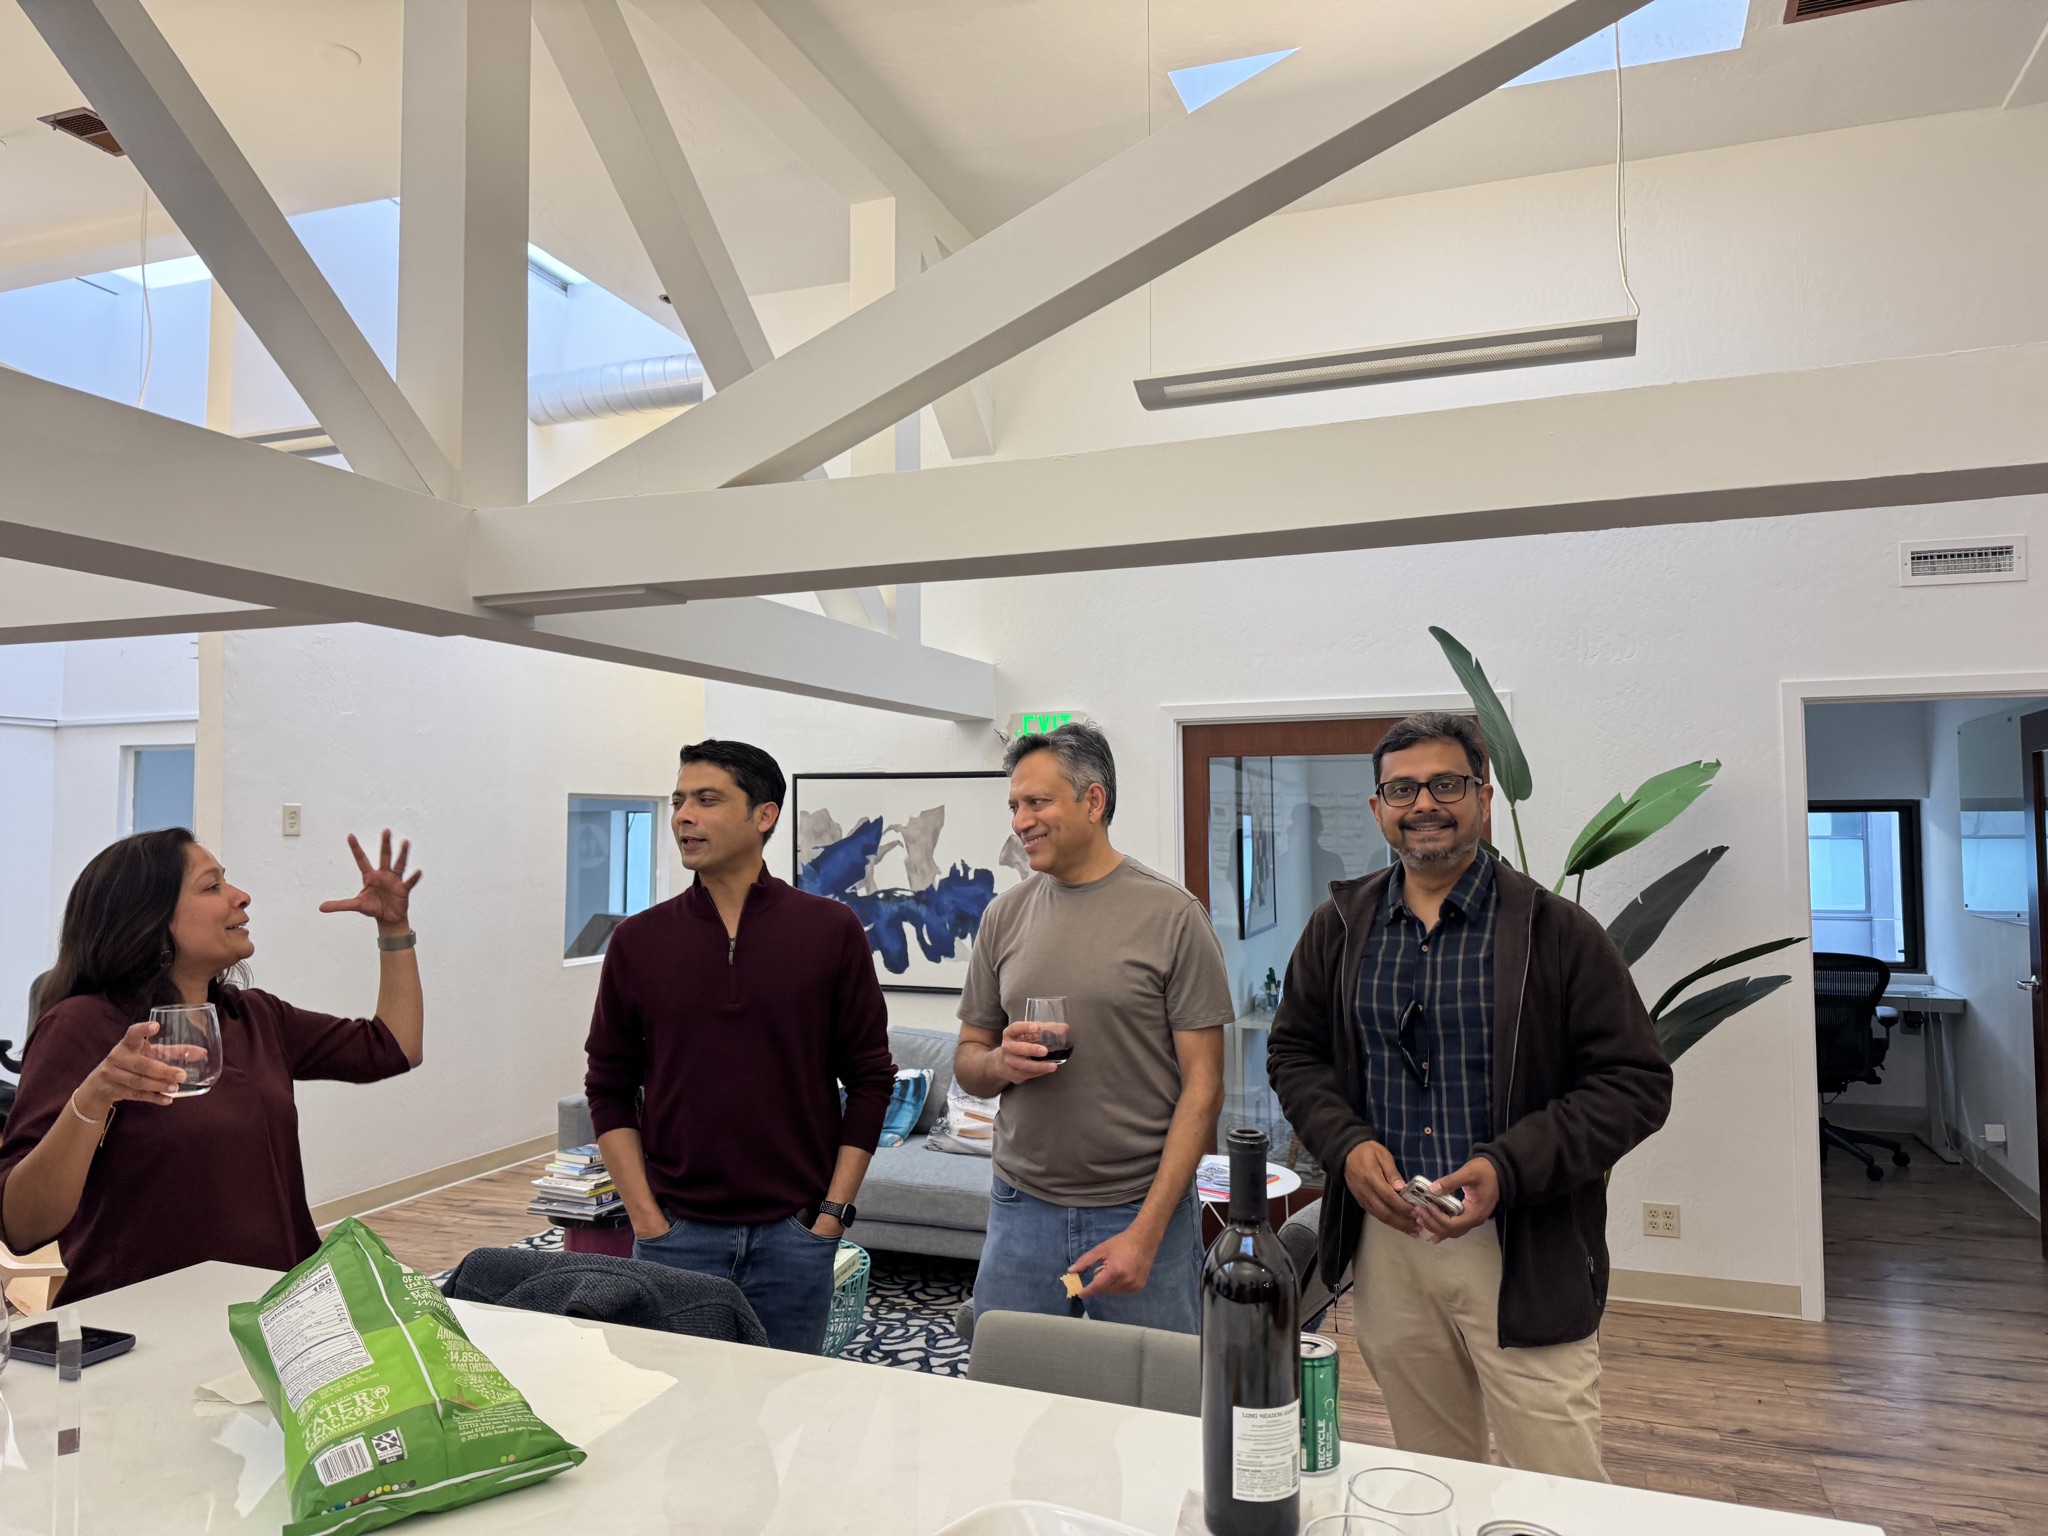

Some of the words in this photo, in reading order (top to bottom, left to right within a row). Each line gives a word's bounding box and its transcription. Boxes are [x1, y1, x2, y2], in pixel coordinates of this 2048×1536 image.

[312, 1278, 332, 1293] 150
[402, 1275, 413, 1283] OF
[405, 1281, 422, 1290] USE
[263, 1300, 300, 1327] Calories
[1242, 1411, 1258, 1419] LONG
[1317, 1419, 1326, 1468] RECYCLE
[1325, 1450, 1333, 1468] ME
